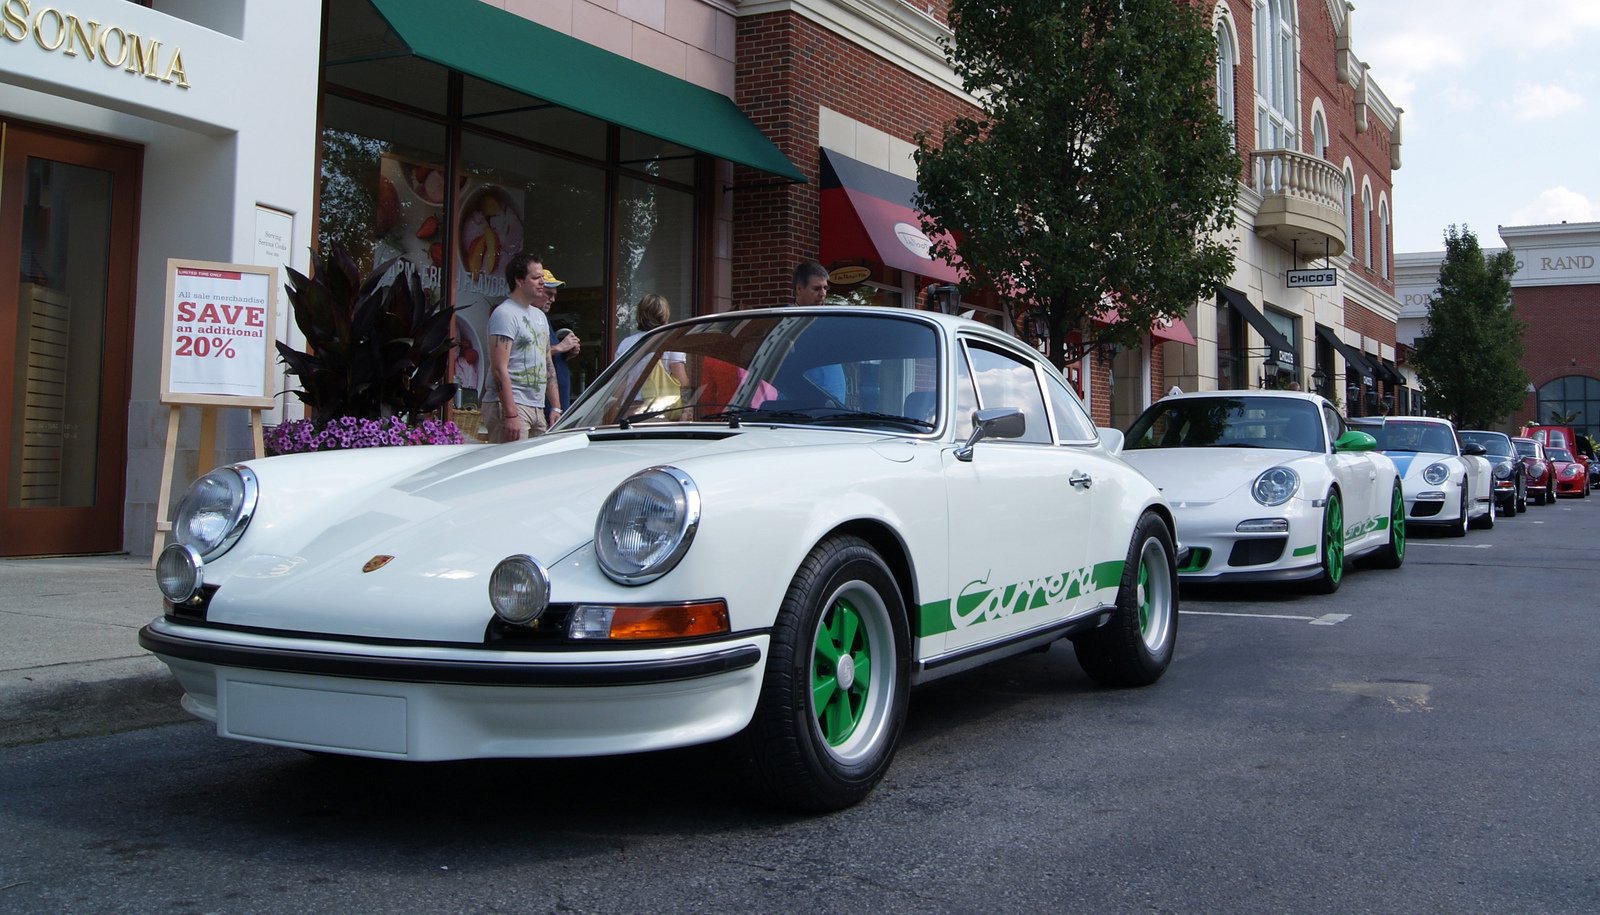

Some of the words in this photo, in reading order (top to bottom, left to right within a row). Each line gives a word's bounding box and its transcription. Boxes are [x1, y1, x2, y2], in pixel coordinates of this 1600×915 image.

[1540, 255, 1595, 271] RAND
[1290, 273, 1333, 283] CHICO'S
[178, 291, 191, 299] All
[213, 294, 265, 304] merchandise
[177, 301, 265, 327] SAVE
[197, 326, 263, 338] additional
[175, 336, 236, 359] 20%
[950, 563, 1098, 631] Carrera
